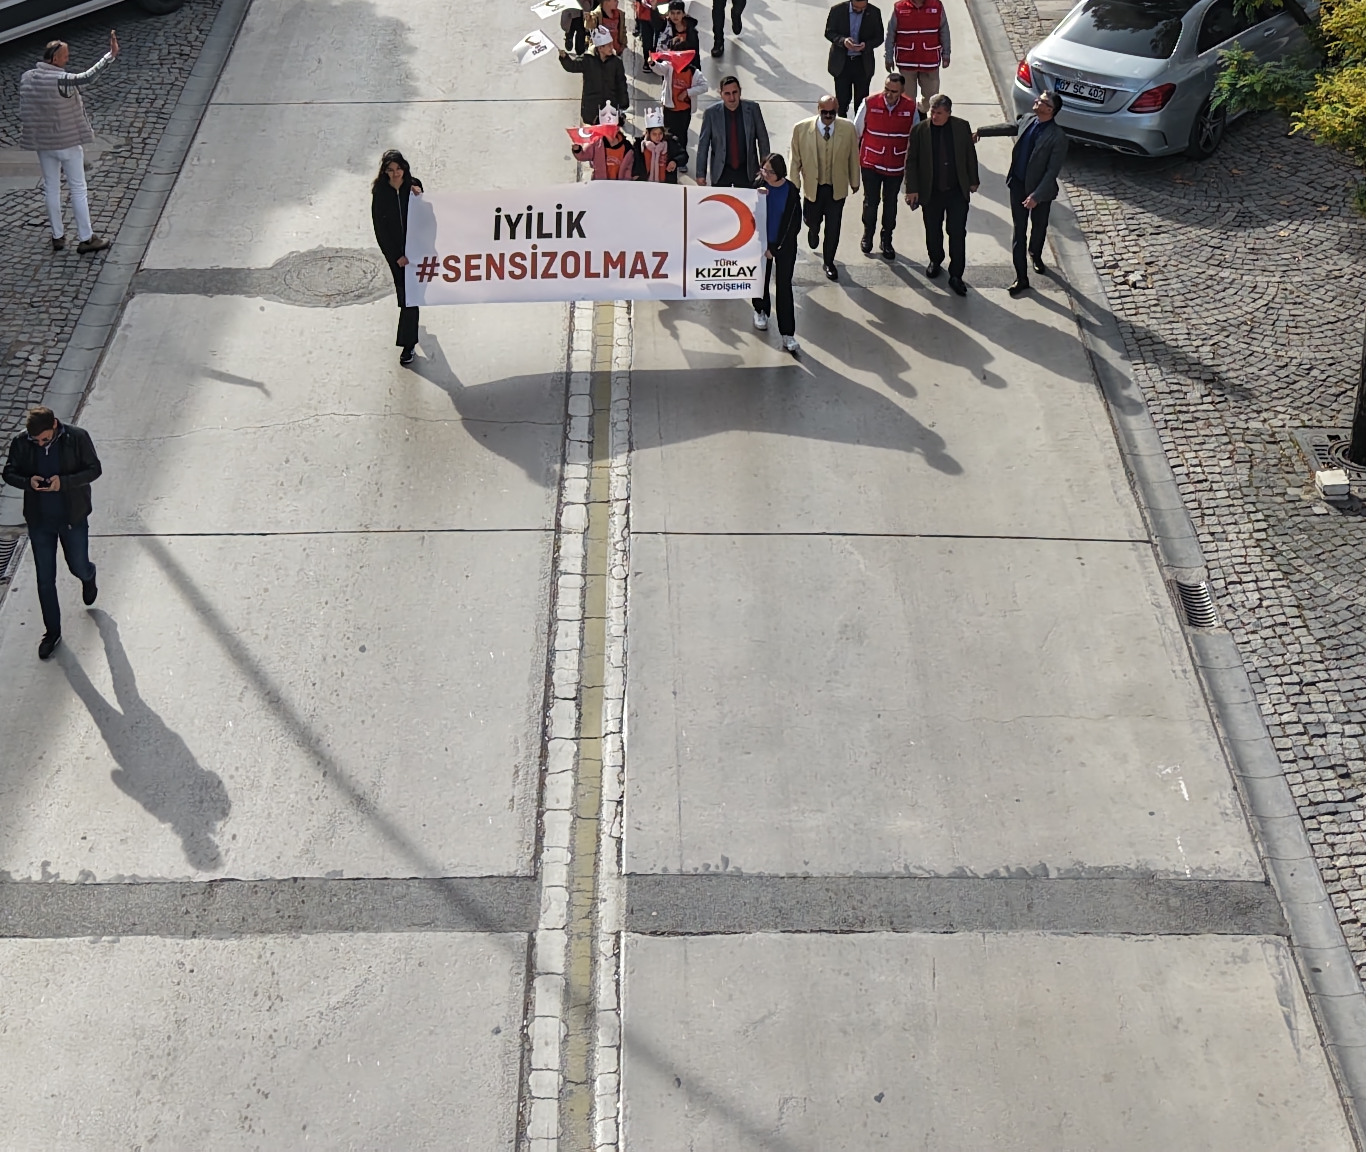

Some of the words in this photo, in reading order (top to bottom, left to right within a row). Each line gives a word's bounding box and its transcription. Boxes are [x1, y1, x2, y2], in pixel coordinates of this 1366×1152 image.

[1073, 84, 1085, 95] SC
[493, 203, 587, 241] İYİLİK
[415, 244, 669, 284] #SENSİZOLMAZ
[714, 258, 738, 268] TÜRK
[695, 266, 757, 279] KIZILAY
[699, 281, 752, 292] SEYDİŞEHİR
